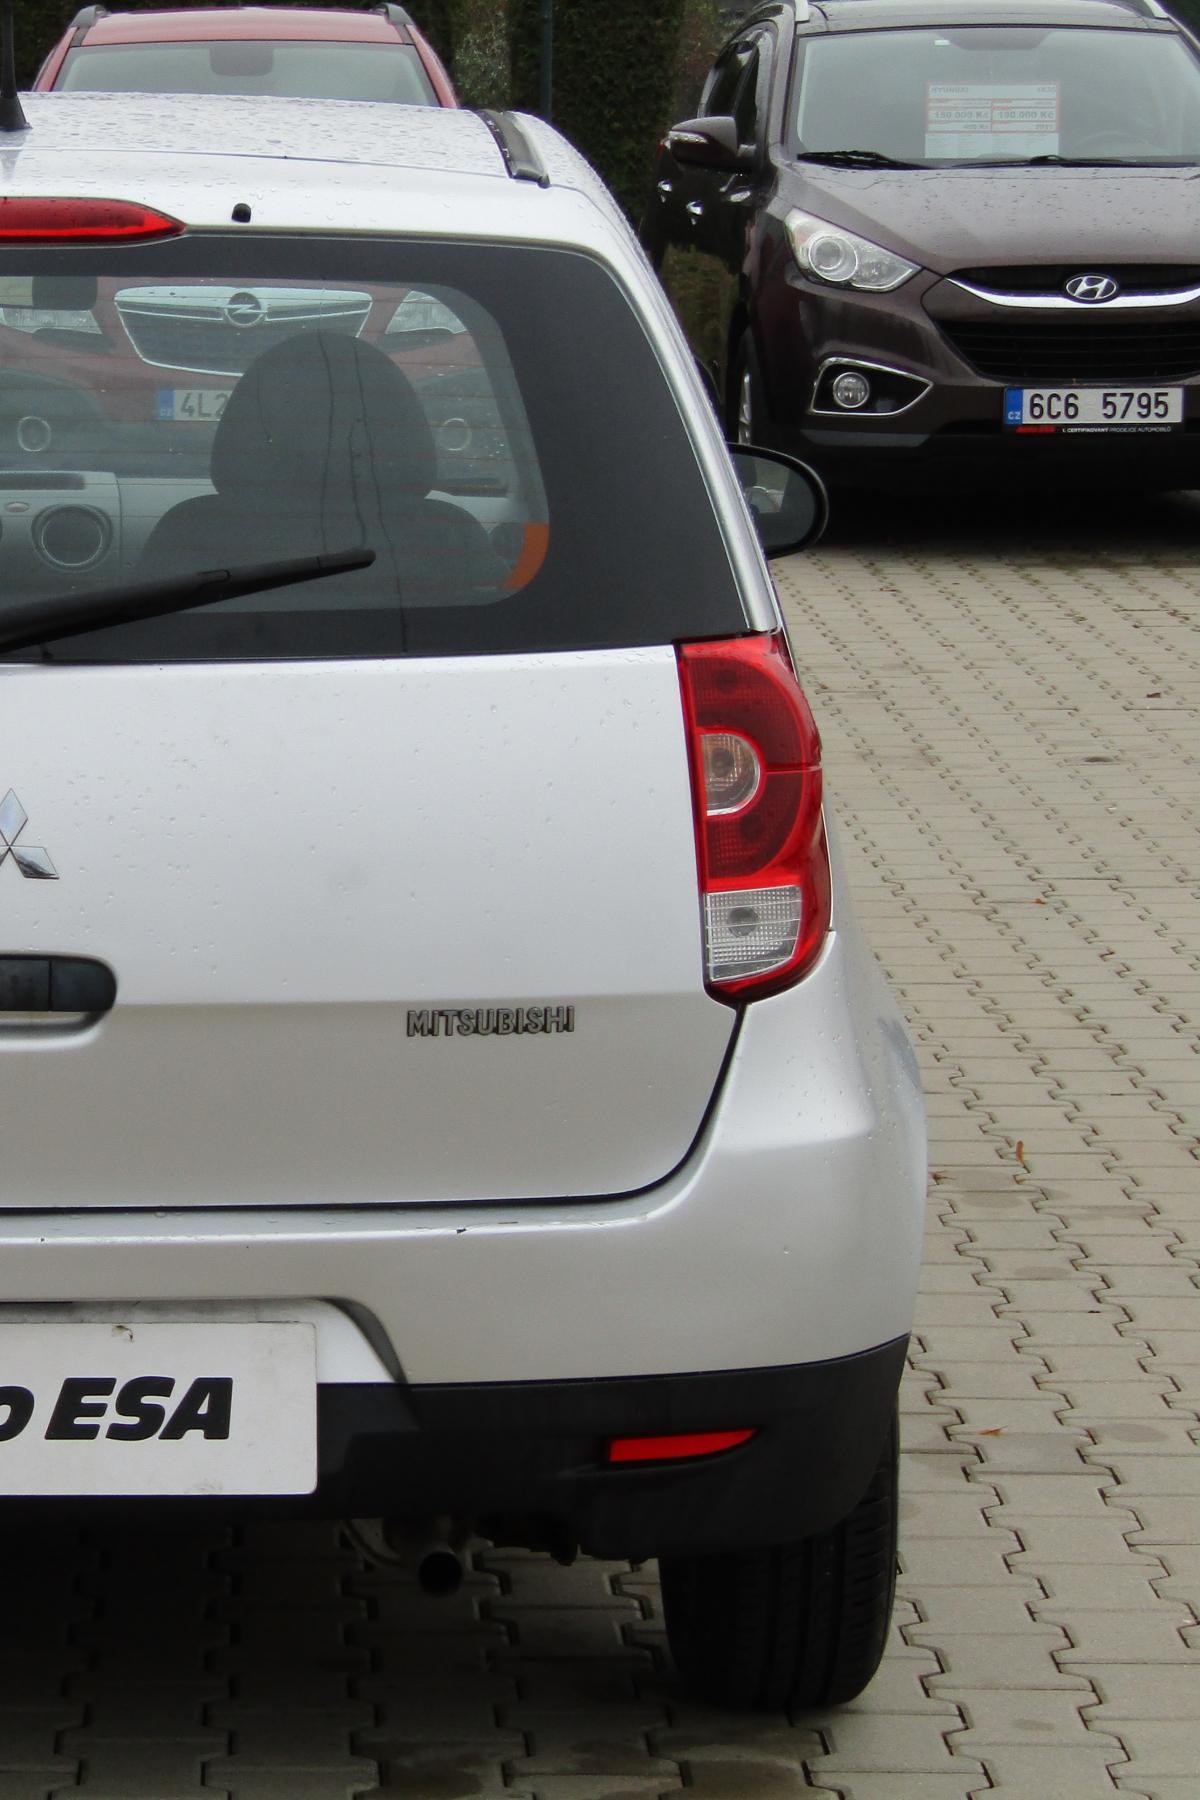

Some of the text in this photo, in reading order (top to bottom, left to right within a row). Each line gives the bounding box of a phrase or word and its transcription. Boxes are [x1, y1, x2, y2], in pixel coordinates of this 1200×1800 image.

[1008, 392, 1169, 420] CZ 6C6 5795
[406, 1005, 575, 1037] MITSUBISHI
[44, 1375, 234, 1441] ESA
